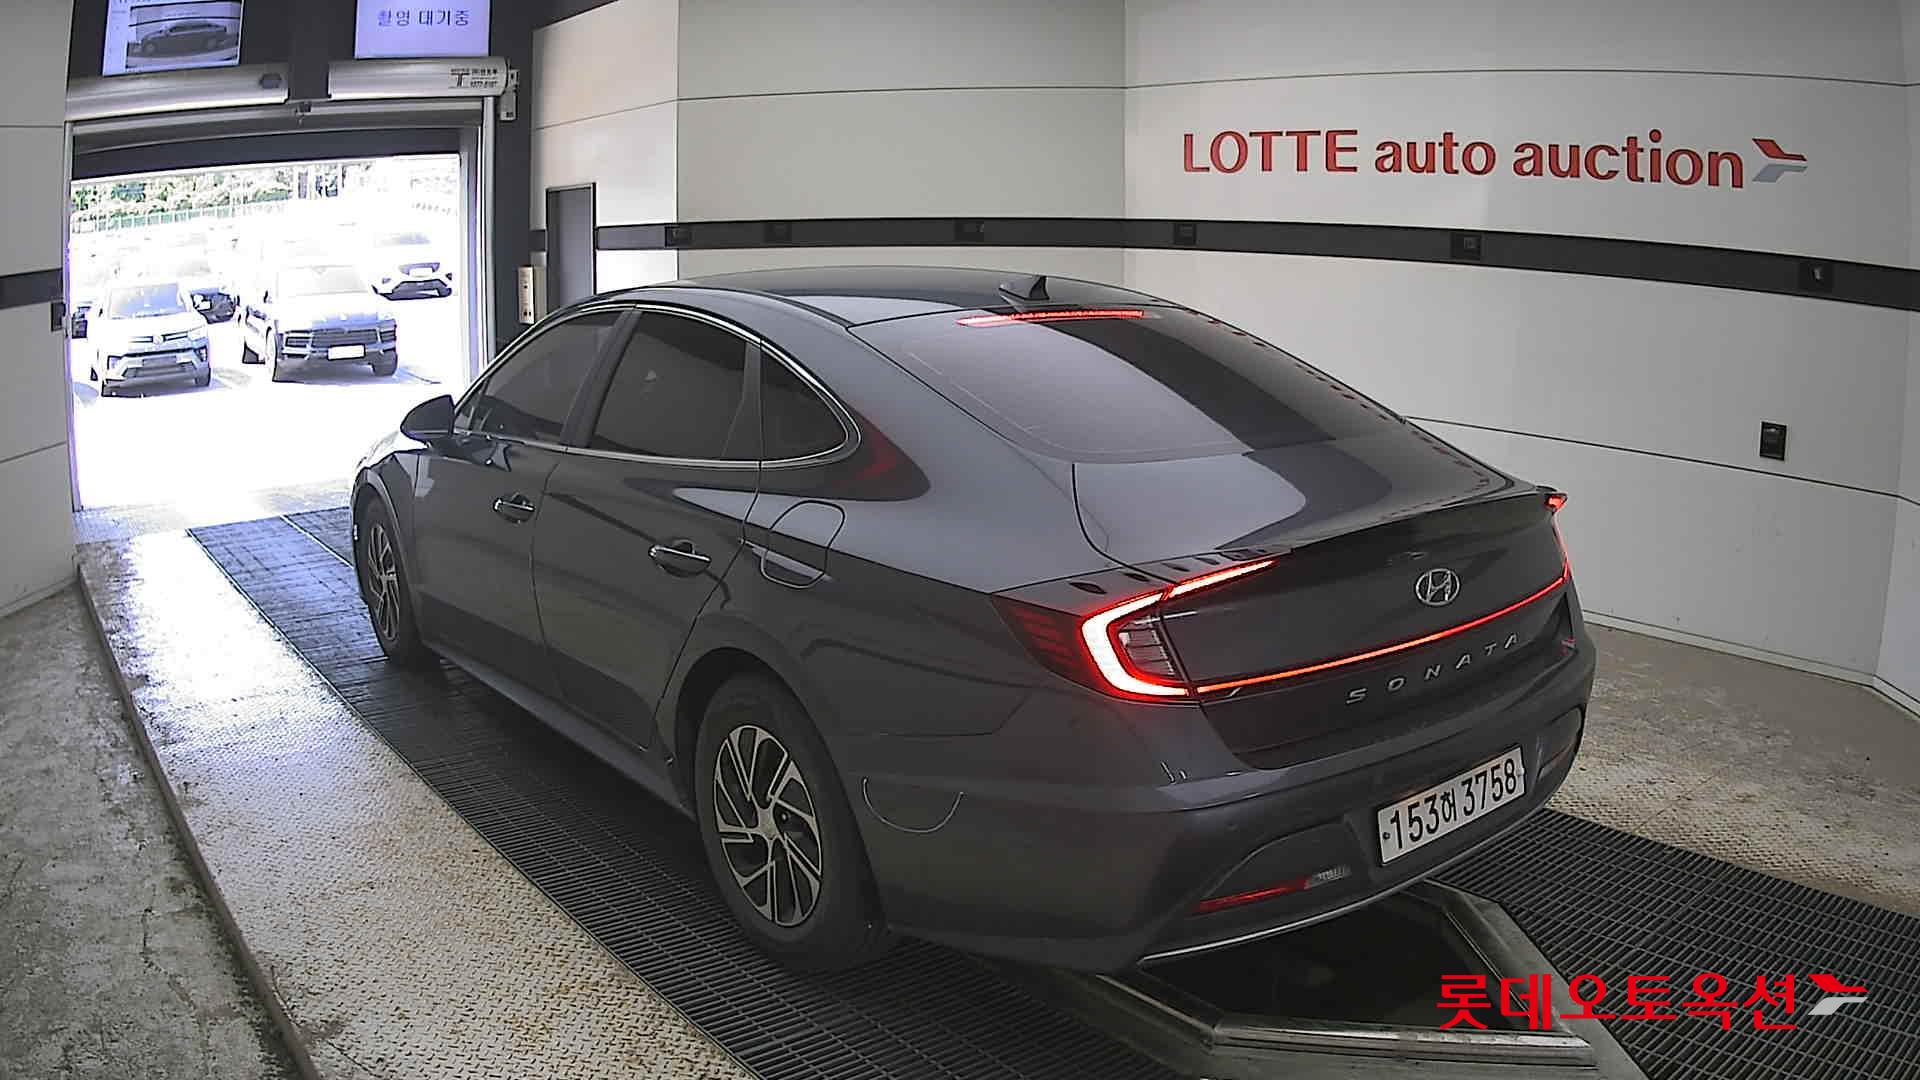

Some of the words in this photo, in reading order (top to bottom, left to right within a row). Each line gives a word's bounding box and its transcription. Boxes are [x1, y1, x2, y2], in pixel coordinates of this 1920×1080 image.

[419, 9, 469, 26] 대기중
[1184, 129, 1358, 173] LOTTE
[1374, 131, 1496, 175] auto
[1513, 129, 1744, 188] auction
[1345, 632, 1519, 704] SONATA
[1461, 758, 1517, 816] 3758
